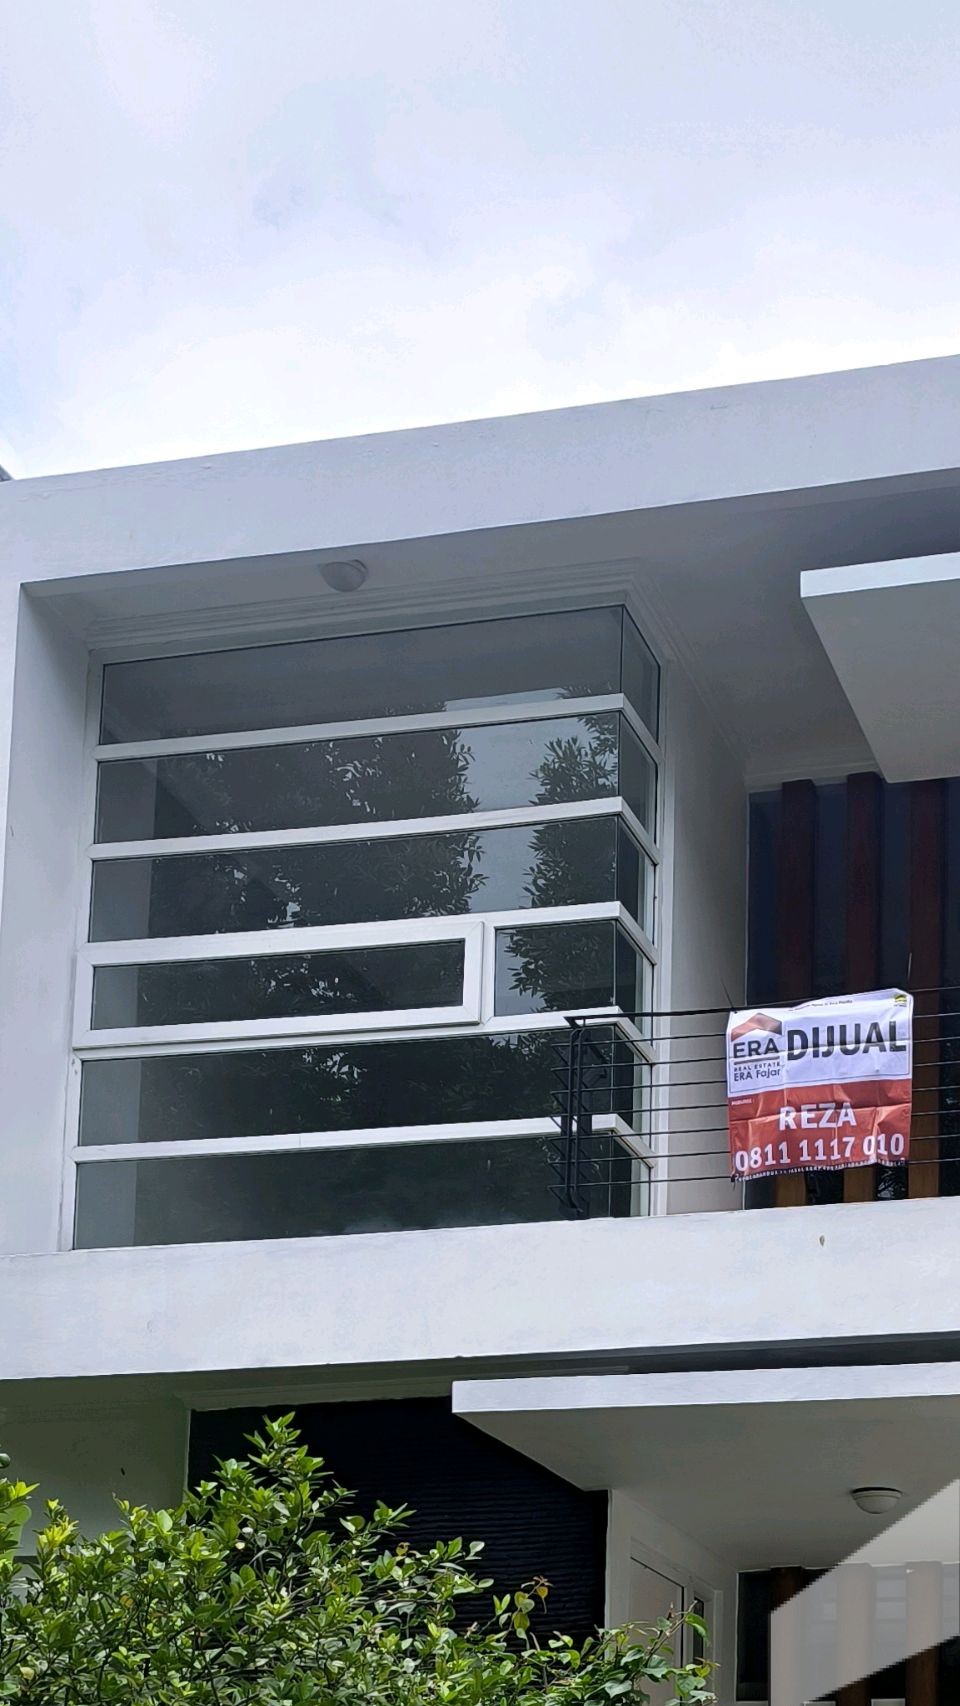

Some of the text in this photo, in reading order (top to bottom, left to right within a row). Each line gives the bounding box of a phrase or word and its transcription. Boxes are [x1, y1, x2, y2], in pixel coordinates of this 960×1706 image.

[733, 1037, 779, 1058] ERA
[787, 1021, 907, 1061] DIJUAL
[733, 1068, 781, 1082] ERA Fajar
[779, 1102, 857, 1131] REZA
[735, 1141, 791, 1172] 0811
[799, 1136, 856, 1161] 1117
[862, 1133, 905, 1156] 010
